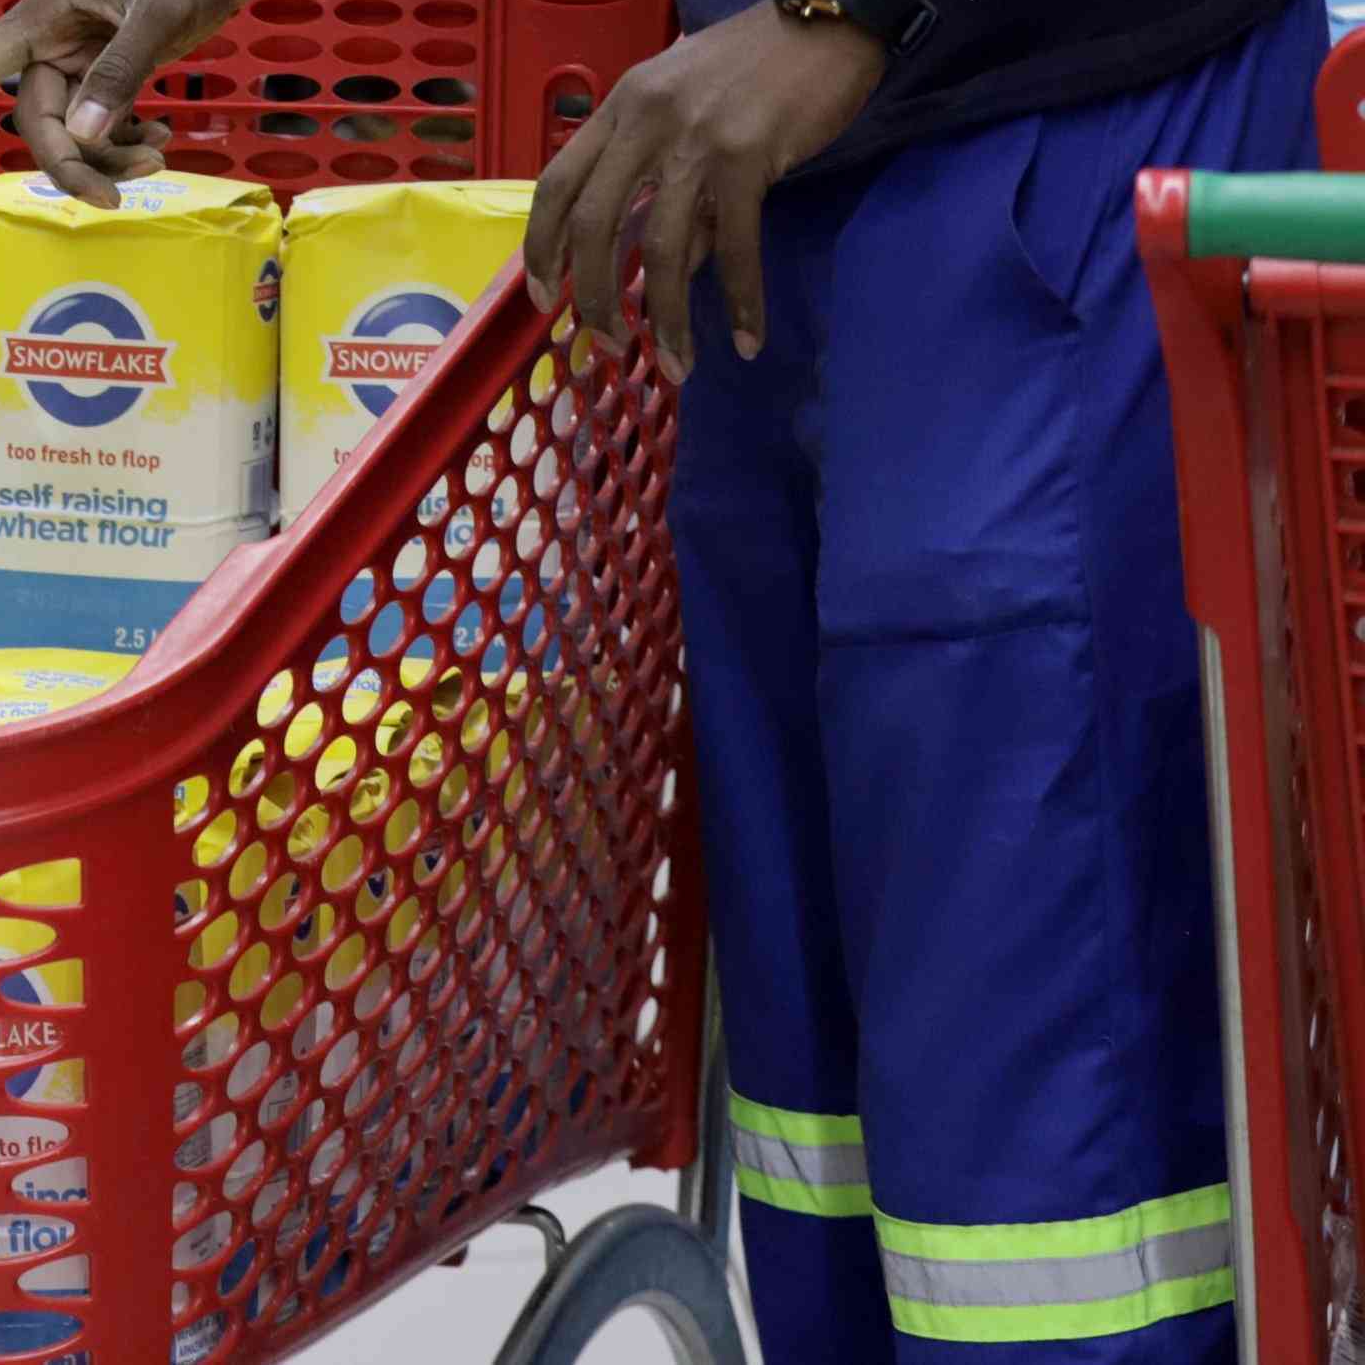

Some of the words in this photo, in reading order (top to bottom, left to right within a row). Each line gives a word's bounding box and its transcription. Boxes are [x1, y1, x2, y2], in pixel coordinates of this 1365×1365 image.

[13, 345, 157, 375] SNOWFLAKE
[336, 349, 429, 372] SNOWF
[6, 442, 37, 461] too
[41, 444, 92, 466] fresh
[98, 449, 117, 467] to
[122, 449, 161, 474] flop
[61, 487, 168, 524] raising
[97, 518, 177, 548] flour
[114, 626, 146, 649] 2.5
